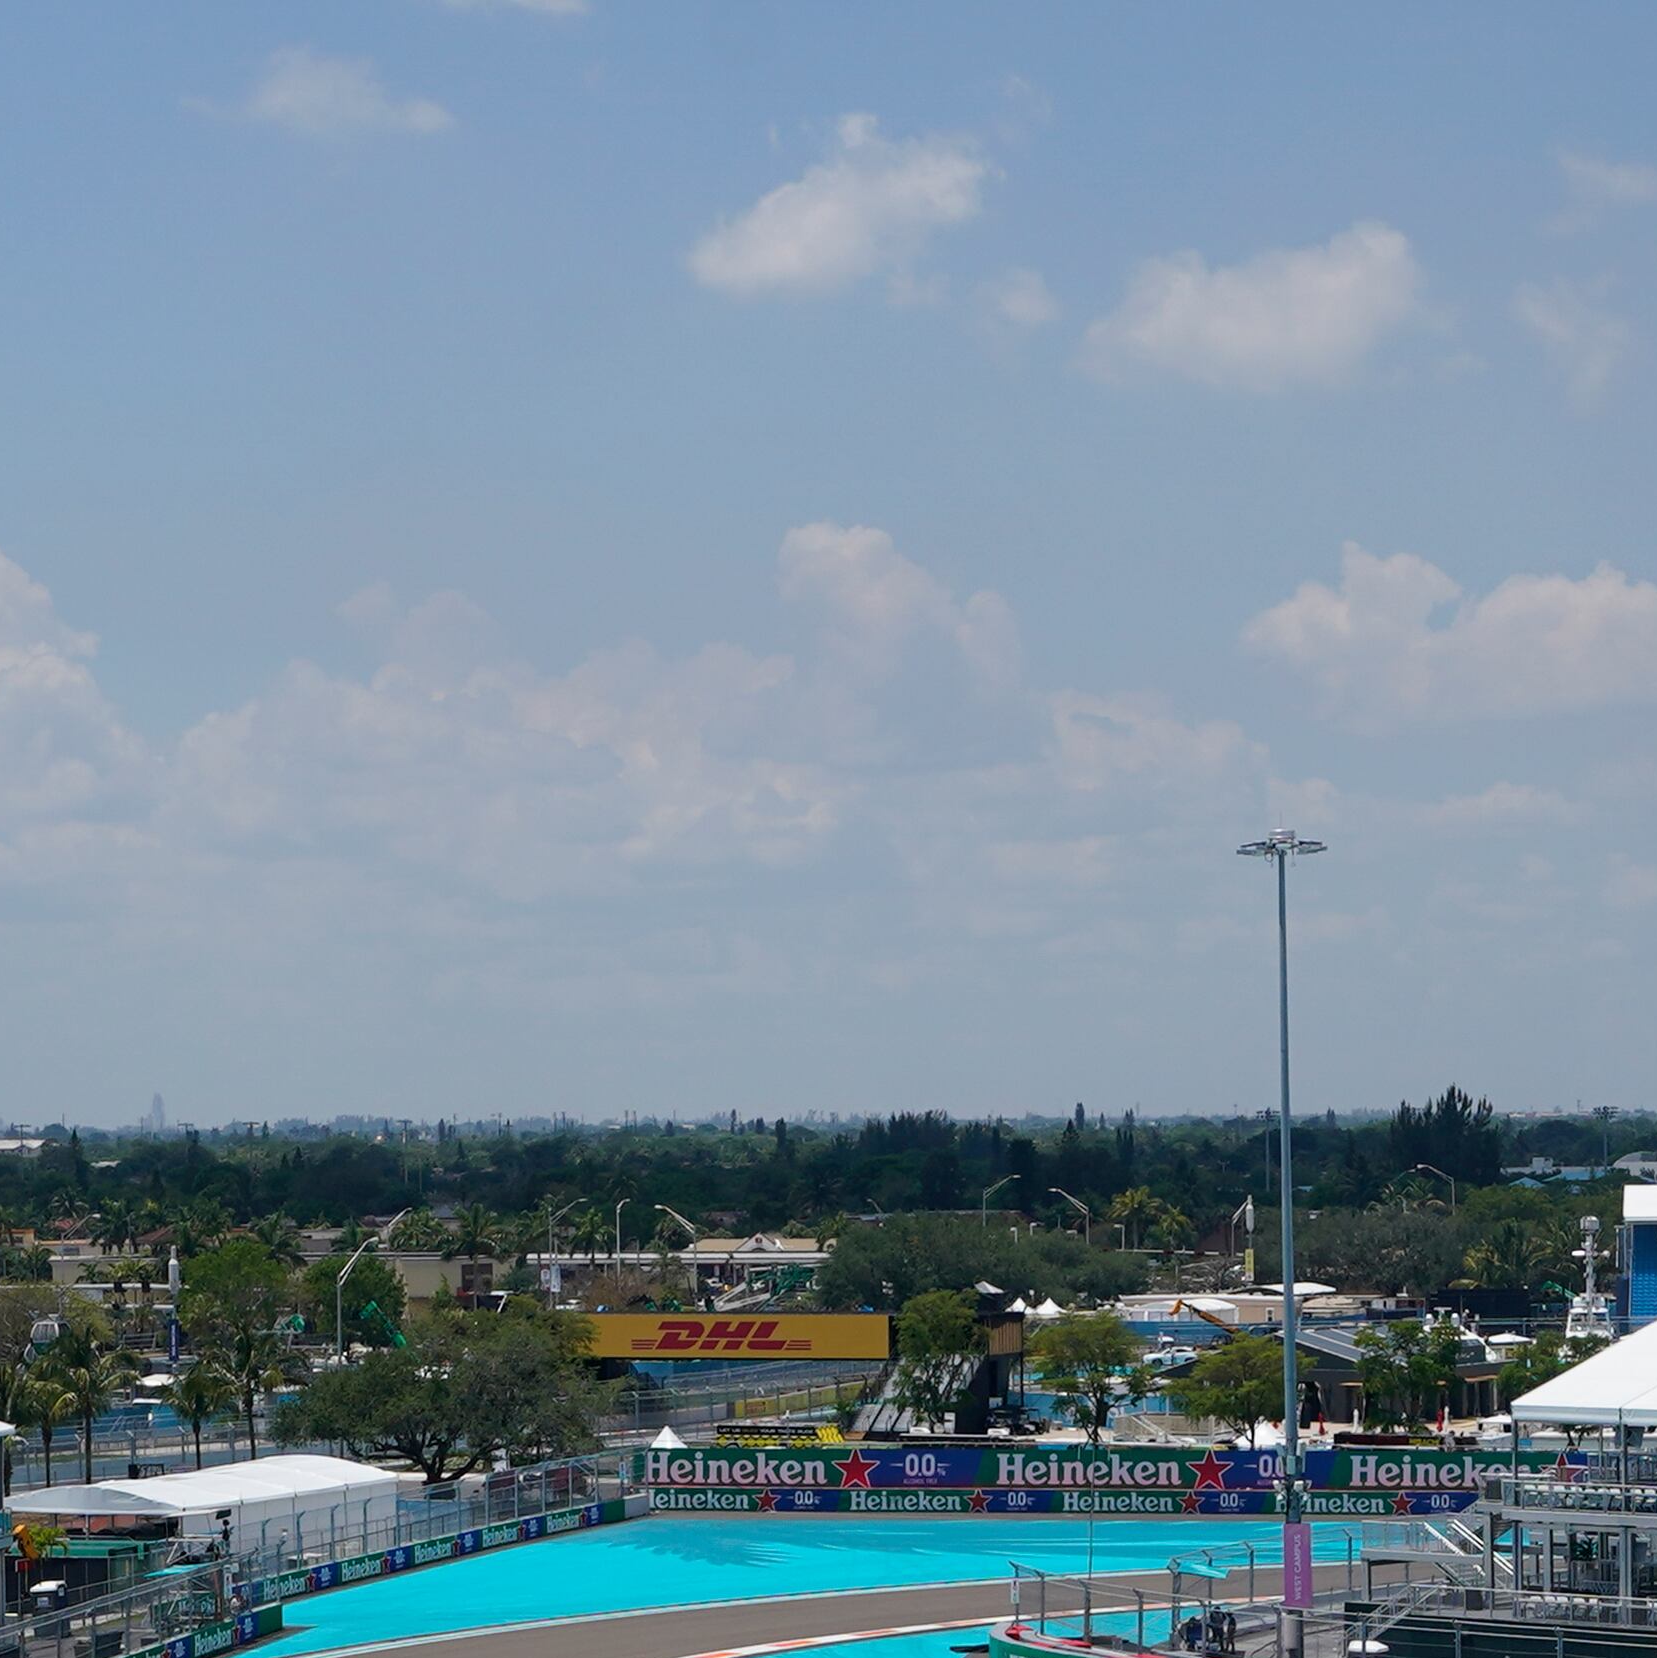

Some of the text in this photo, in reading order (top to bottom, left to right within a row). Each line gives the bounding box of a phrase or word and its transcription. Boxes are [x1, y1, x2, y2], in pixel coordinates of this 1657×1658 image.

[655, 1321, 788, 1350] DHL
[647, 1452, 829, 1485] Heineken
[996, 1453, 1182, 1485] Heineken
[849, 1491, 962, 1511] Heineken
[1062, 1492, 1174, 1512] Heineken
[415, 1539, 453, 1563] Heineken
[1293, 1534, 1302, 1573] CAMPUS
[342, 1556, 381, 1582] Heineken
[263, 1574, 306, 1601] Heineken
[194, 1627, 232, 1656] Heineken
